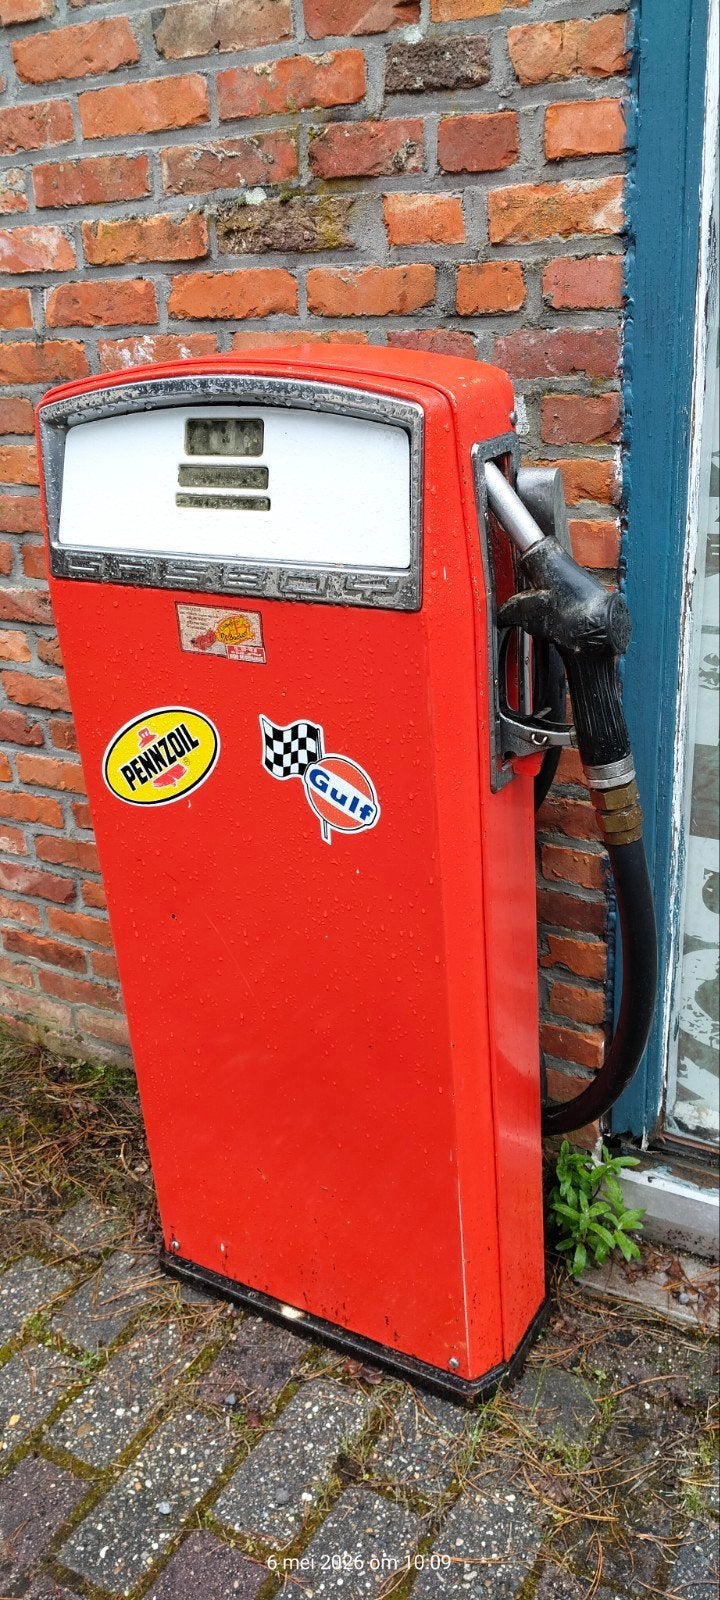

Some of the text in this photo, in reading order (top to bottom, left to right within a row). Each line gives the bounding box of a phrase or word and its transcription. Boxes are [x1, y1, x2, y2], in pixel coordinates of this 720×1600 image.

[65, 551, 400, 601] GASBOY
[119, 723, 200, 791] PENNZOIL
[308, 767, 375, 821] Gulf
